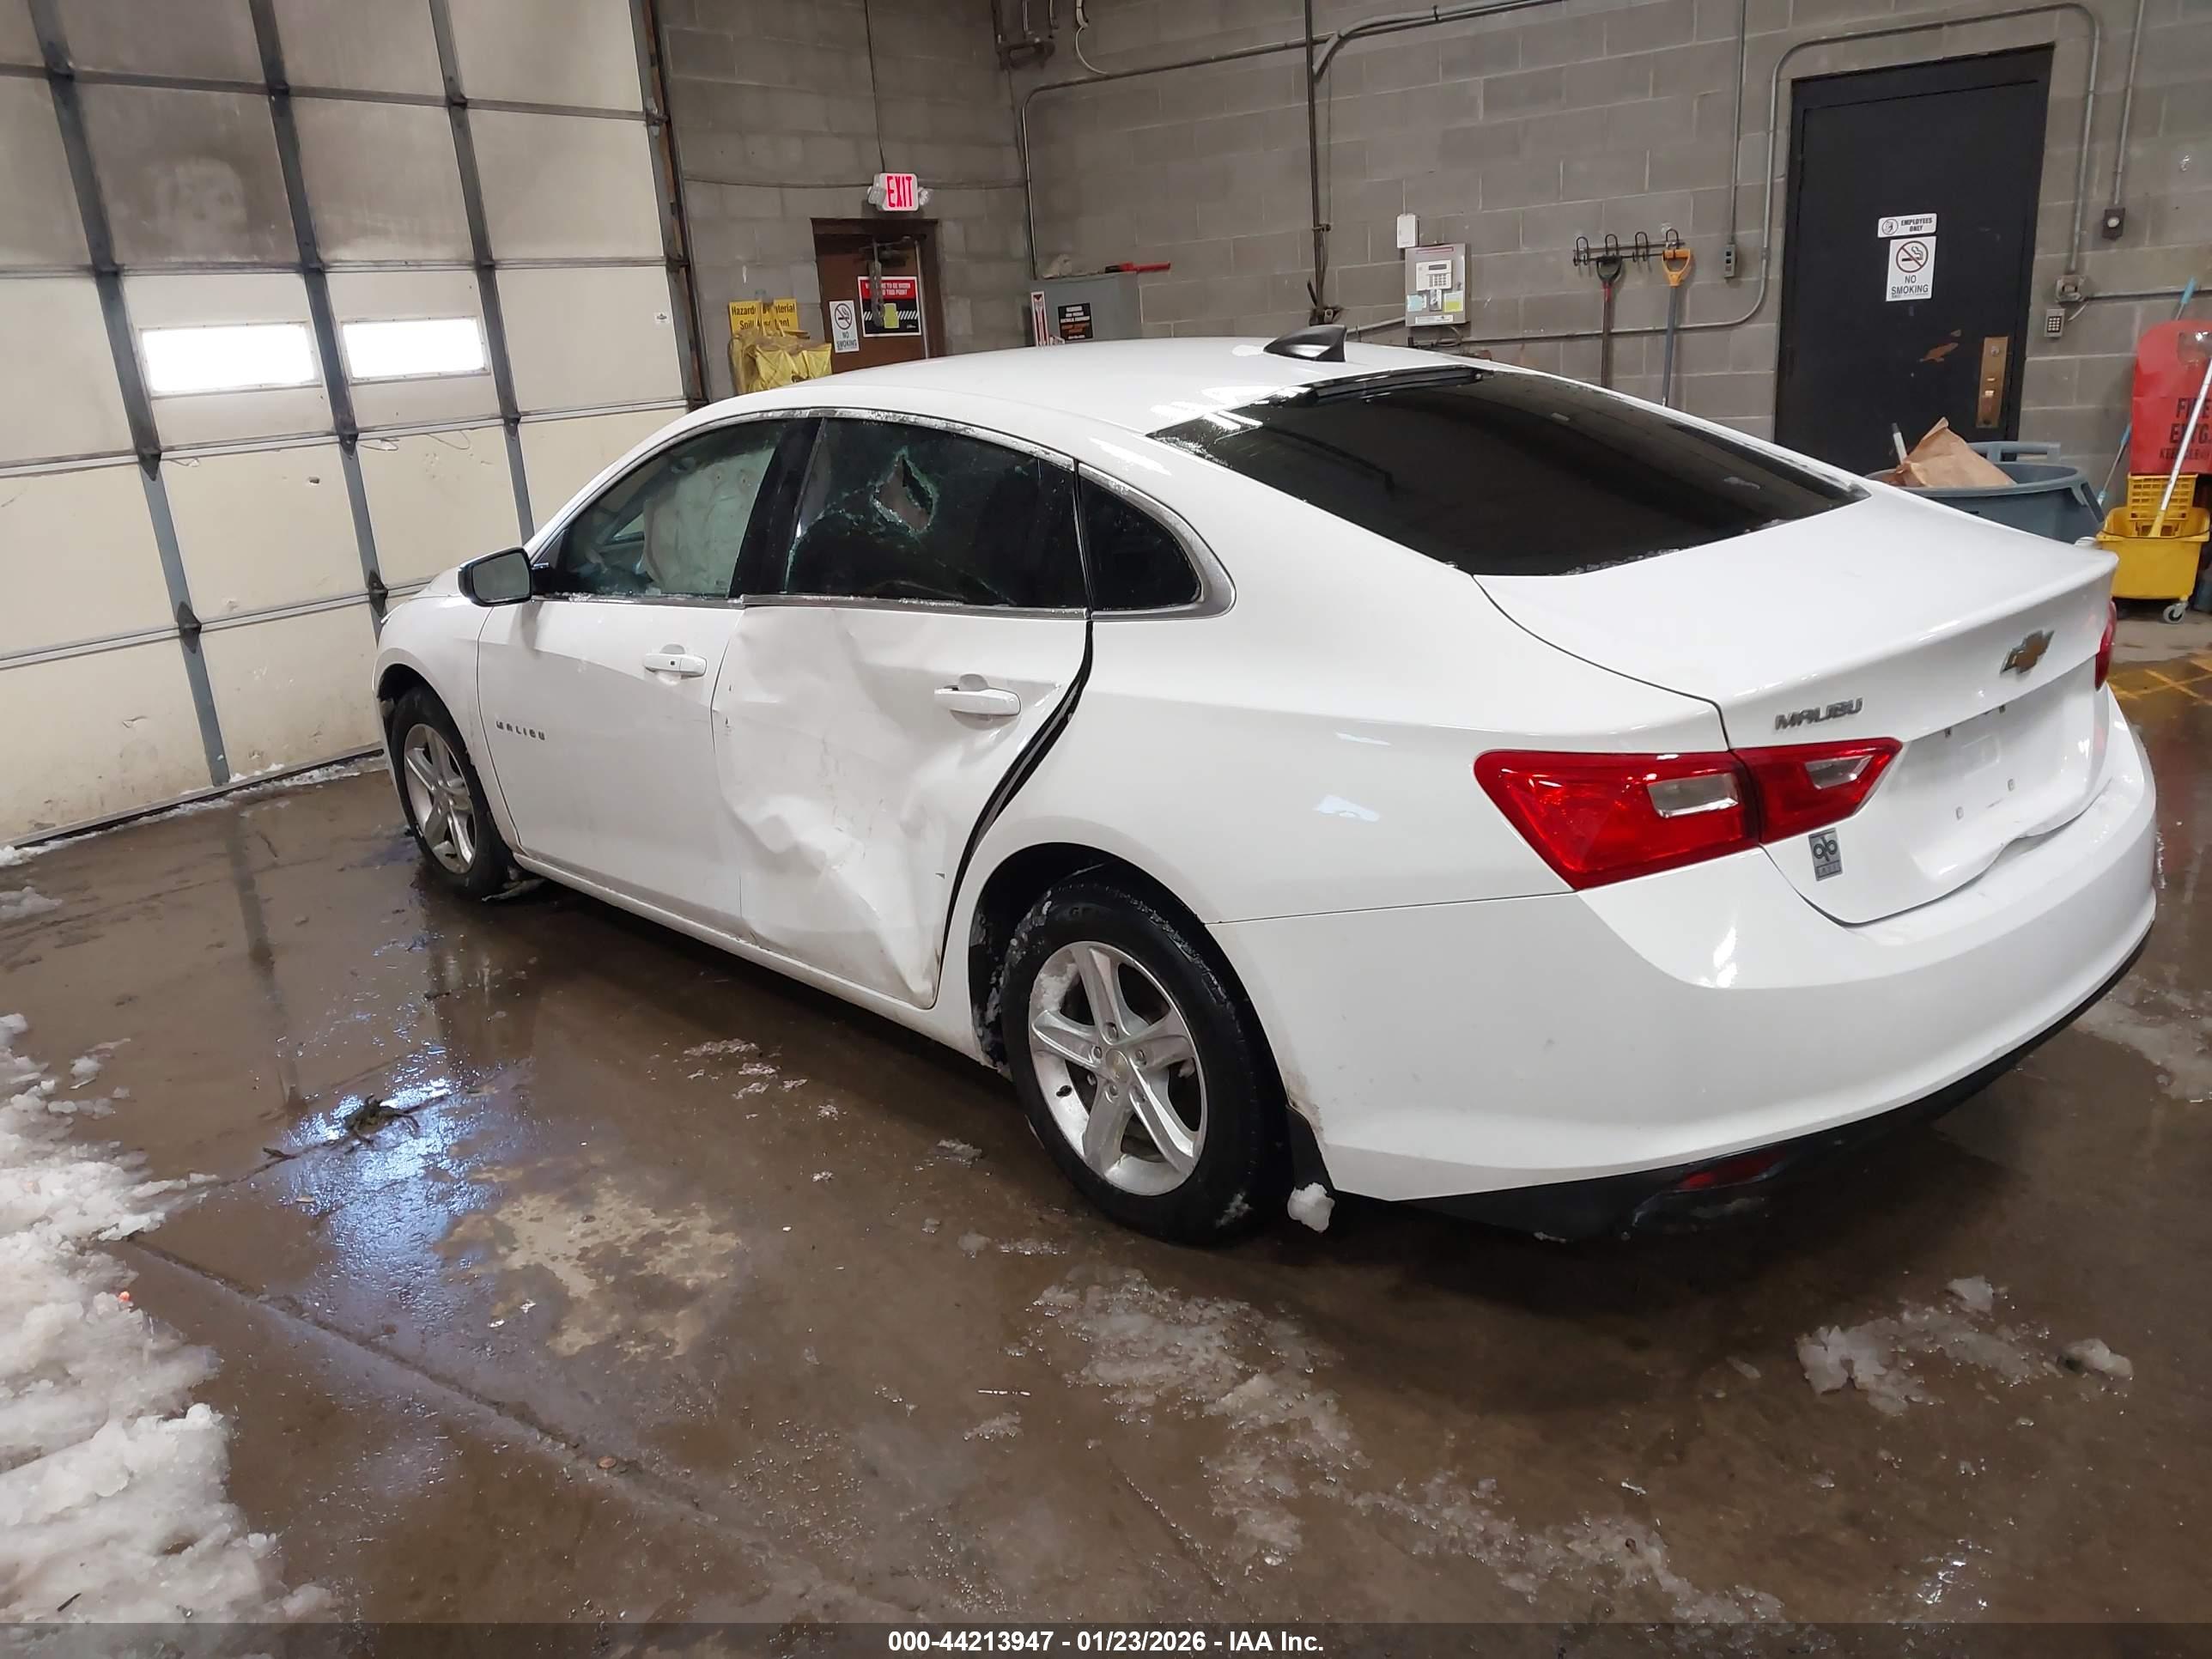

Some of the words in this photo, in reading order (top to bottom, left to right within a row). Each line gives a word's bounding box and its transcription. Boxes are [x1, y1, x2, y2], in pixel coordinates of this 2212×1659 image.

[886, 175, 913, 208] EXIT
[1900, 217, 1933, 226] EMPLOYEES
[1905, 275, 1917, 283] NO
[1891, 284, 1929, 295] SMOKING
[836, 339, 857, 349] SMOKING
[2176, 398, 2212, 419] FIE
[1774, 697, 1863, 731] MALIBU
[495, 720, 546, 741] MALIBU
